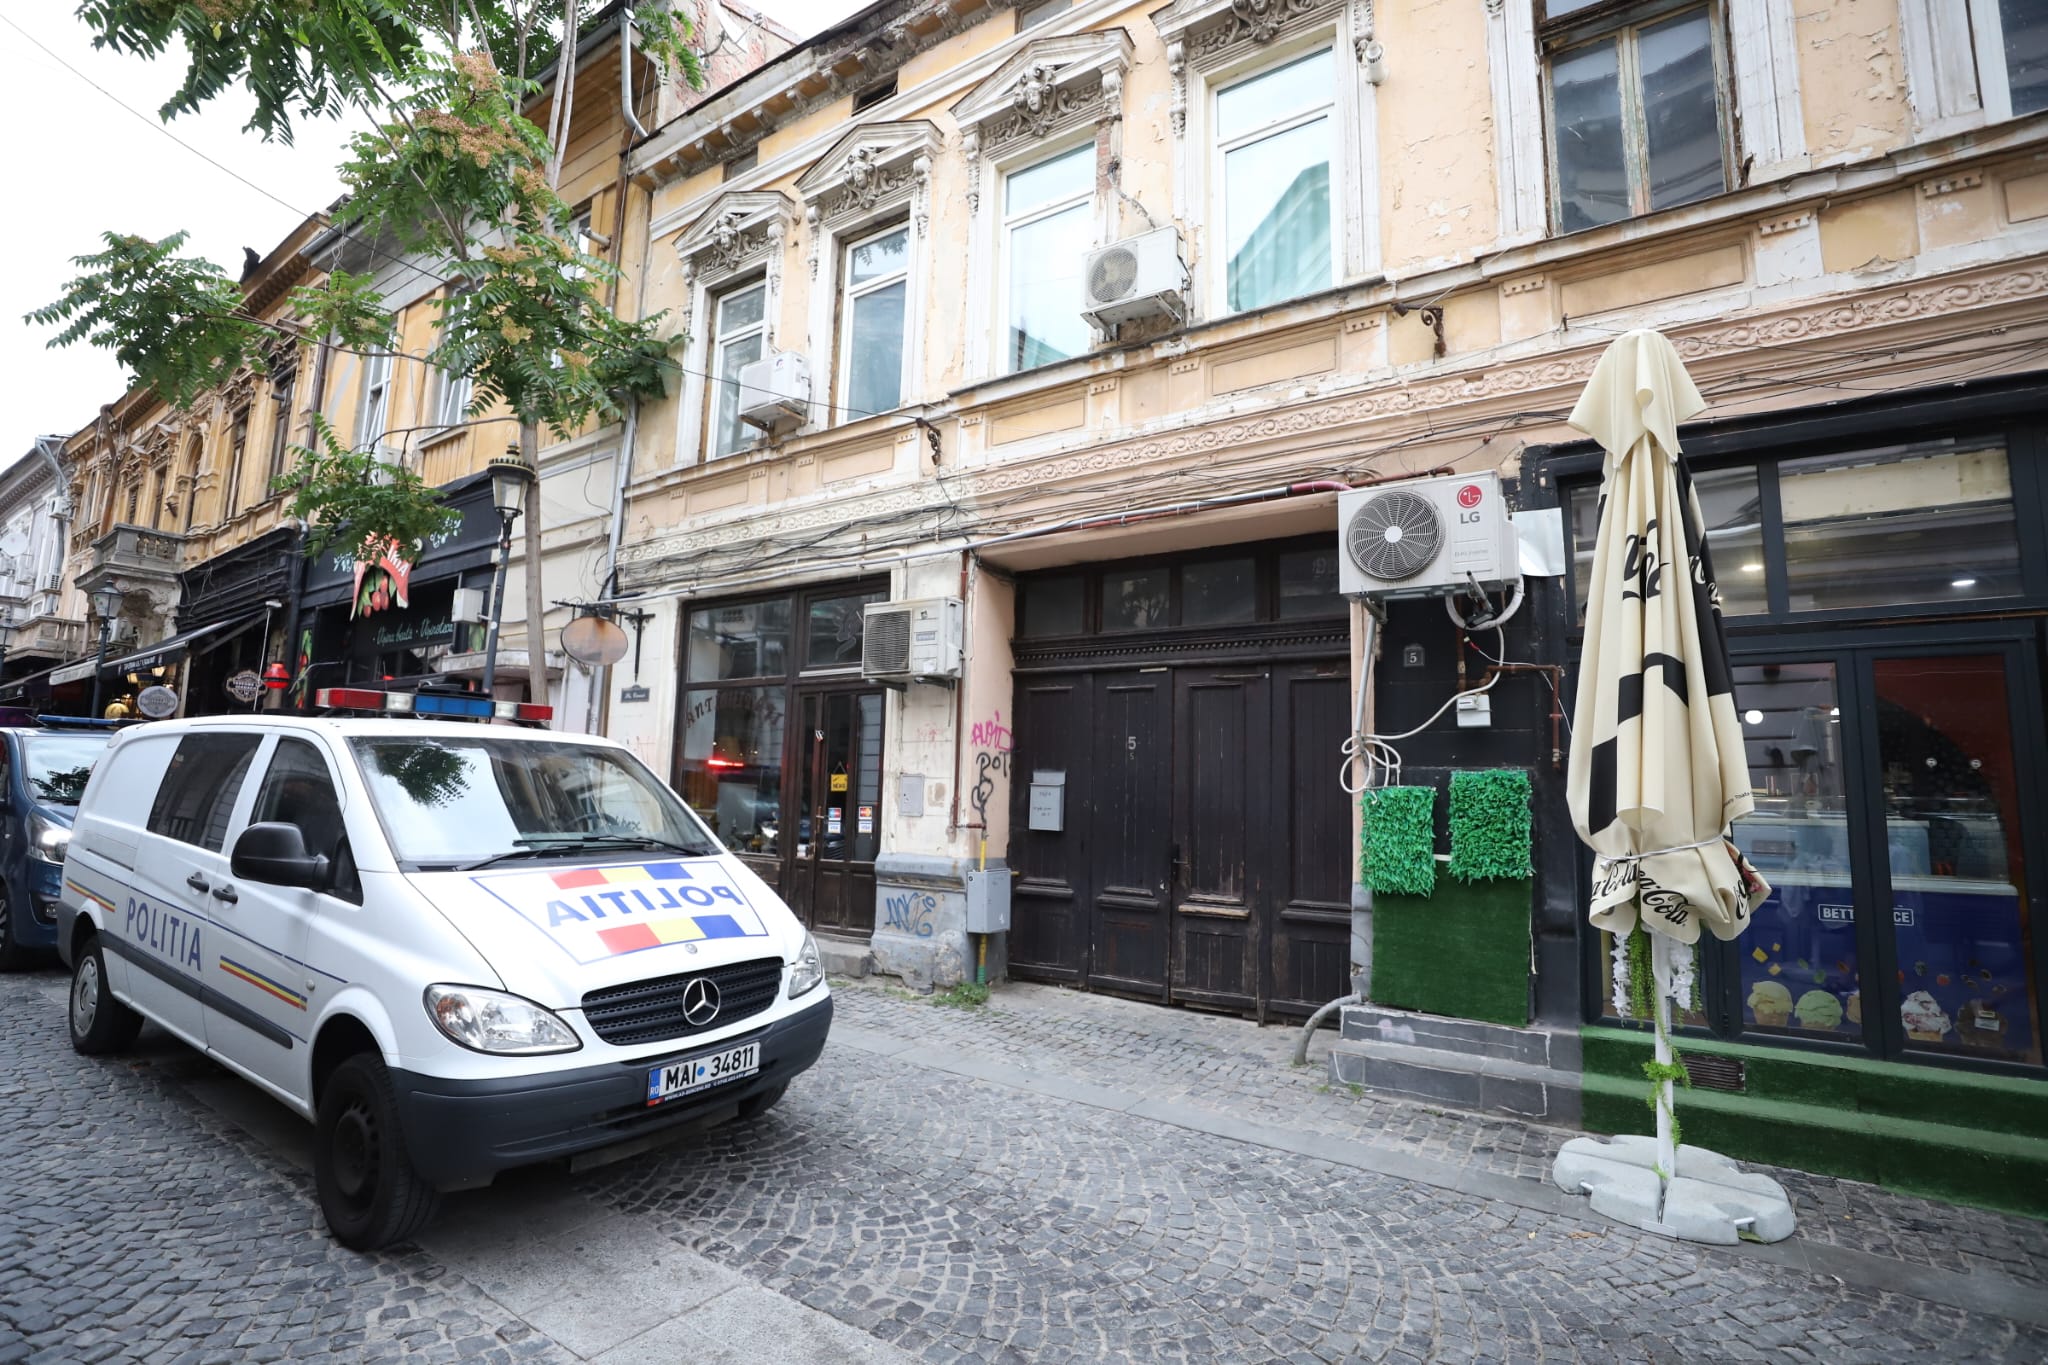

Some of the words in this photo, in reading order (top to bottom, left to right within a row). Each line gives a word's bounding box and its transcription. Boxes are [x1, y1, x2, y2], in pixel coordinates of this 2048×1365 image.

[1460, 511, 1481, 525] LG
[1410, 652, 1416, 664] 5
[1128, 736, 1136, 750] 5
[1823, 907, 1854, 920] BETT
[1893, 911, 1910, 923] CE
[126, 896, 201, 971] POLITIA
[665, 1063, 697, 1091] MAI
[710, 1046, 754, 1078] 34811
[650, 1085, 659, 1096] RO
